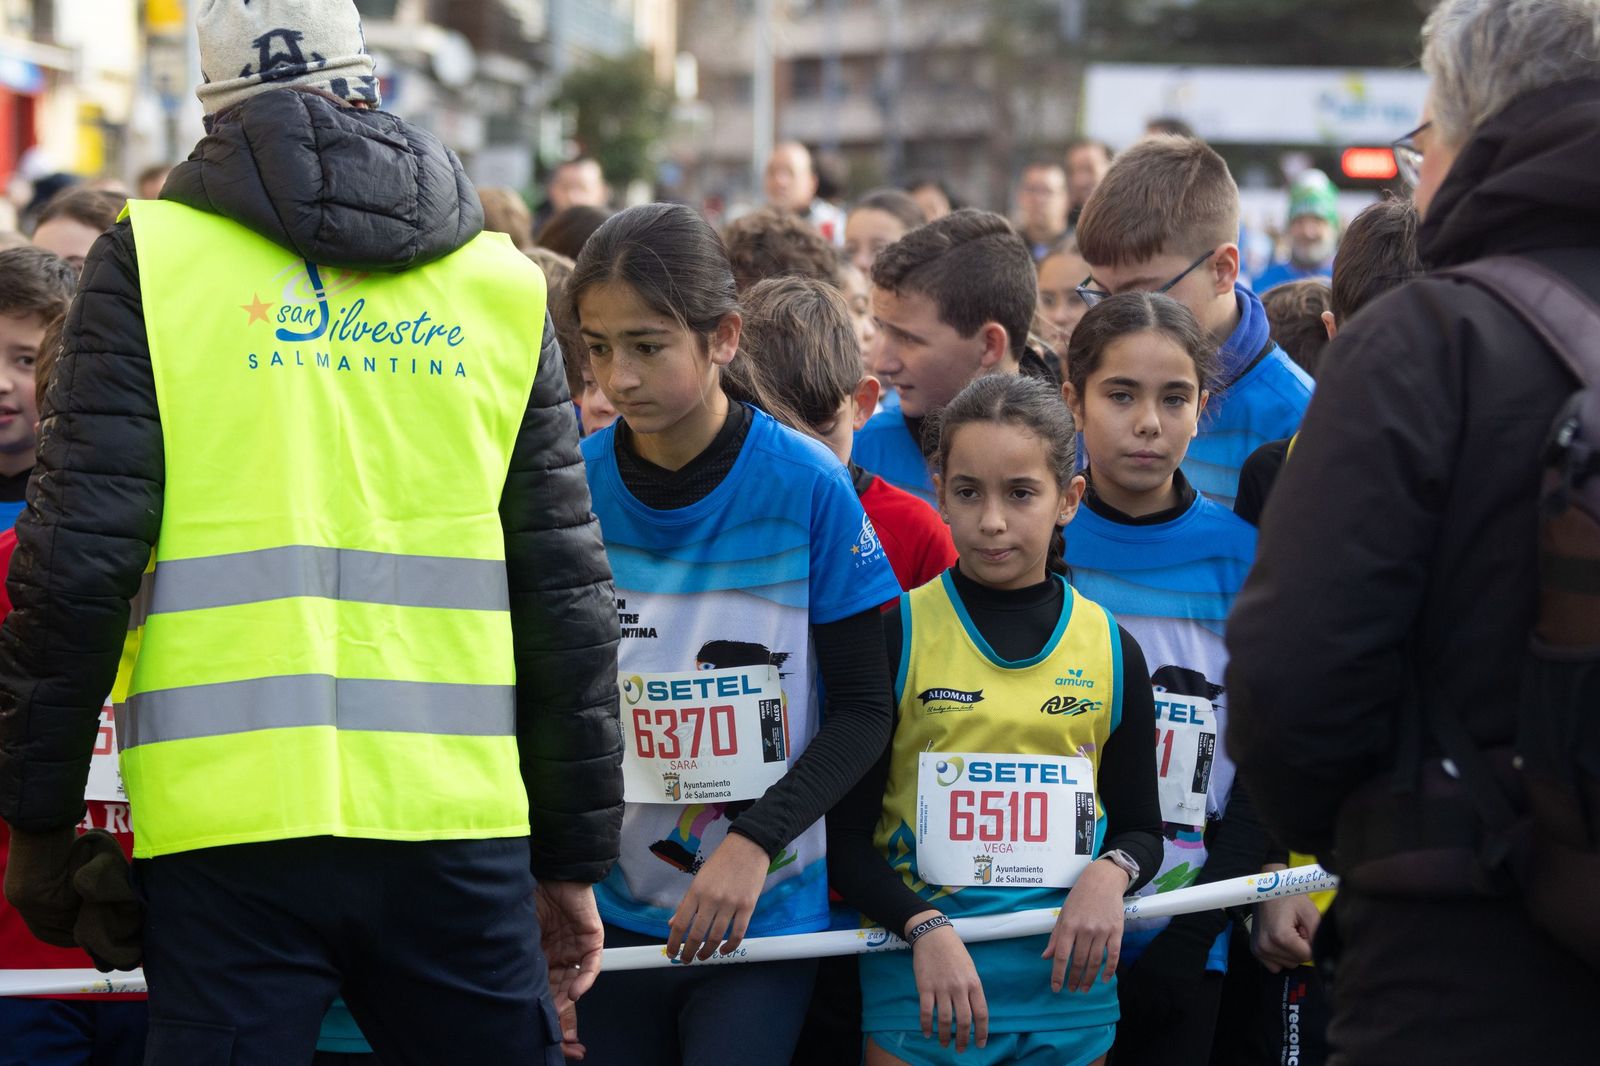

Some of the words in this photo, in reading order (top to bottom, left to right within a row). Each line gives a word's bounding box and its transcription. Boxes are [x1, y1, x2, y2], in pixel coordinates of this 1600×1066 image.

[248, 350, 466, 377] SALMANTINA
[646, 674, 762, 702] SETEL
[1054, 676, 1095, 689] amura
[928, 690, 974, 702] ALJOMAR
[632, 705, 738, 759] 6370
[670, 760, 698, 771] SARA
[968, 761, 1078, 785] SETEL
[683, 779, 731, 790] Ayuntamiento
[684, 792, 693, 800] de
[694, 790, 732, 800] Salamanca
[949, 790, 1049, 843] 6510
[983, 843, 1014, 854] VEGA
[995, 865, 1044, 875] Ayuntamiento
[995, 875, 1003, 883] de
[1005, 875, 1043, 884] Salamanca
